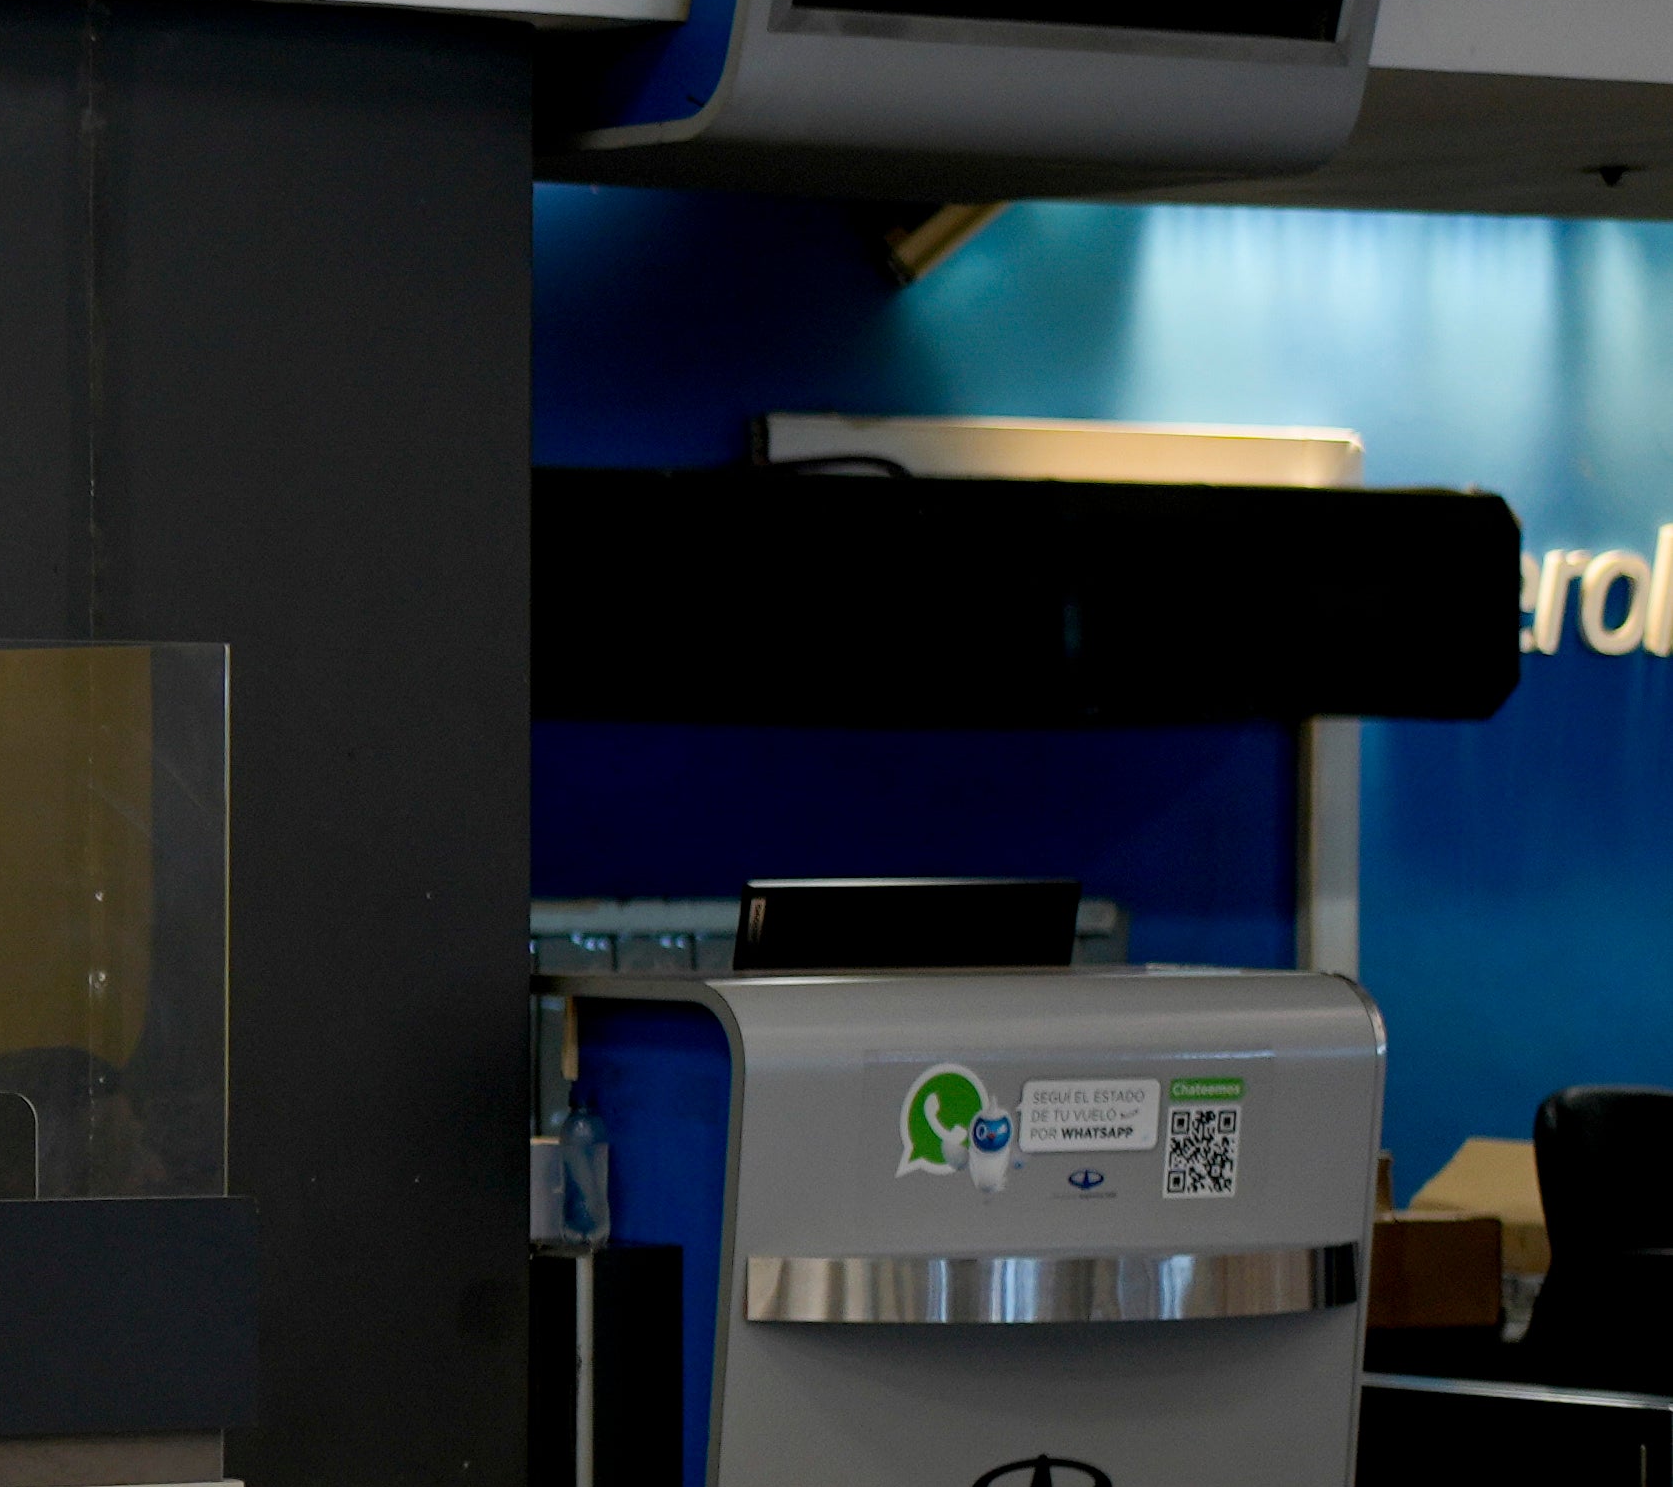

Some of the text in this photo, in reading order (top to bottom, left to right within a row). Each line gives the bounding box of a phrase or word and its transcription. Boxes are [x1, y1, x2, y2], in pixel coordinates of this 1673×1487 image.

[1074, 1091, 1089, 1104] EL
[1093, 1090, 1145, 1104] ESTADO
[1030, 1108, 1117, 1123] DE TU VUELO
[1030, 1126, 1134, 1140] POR WHATSAPP
